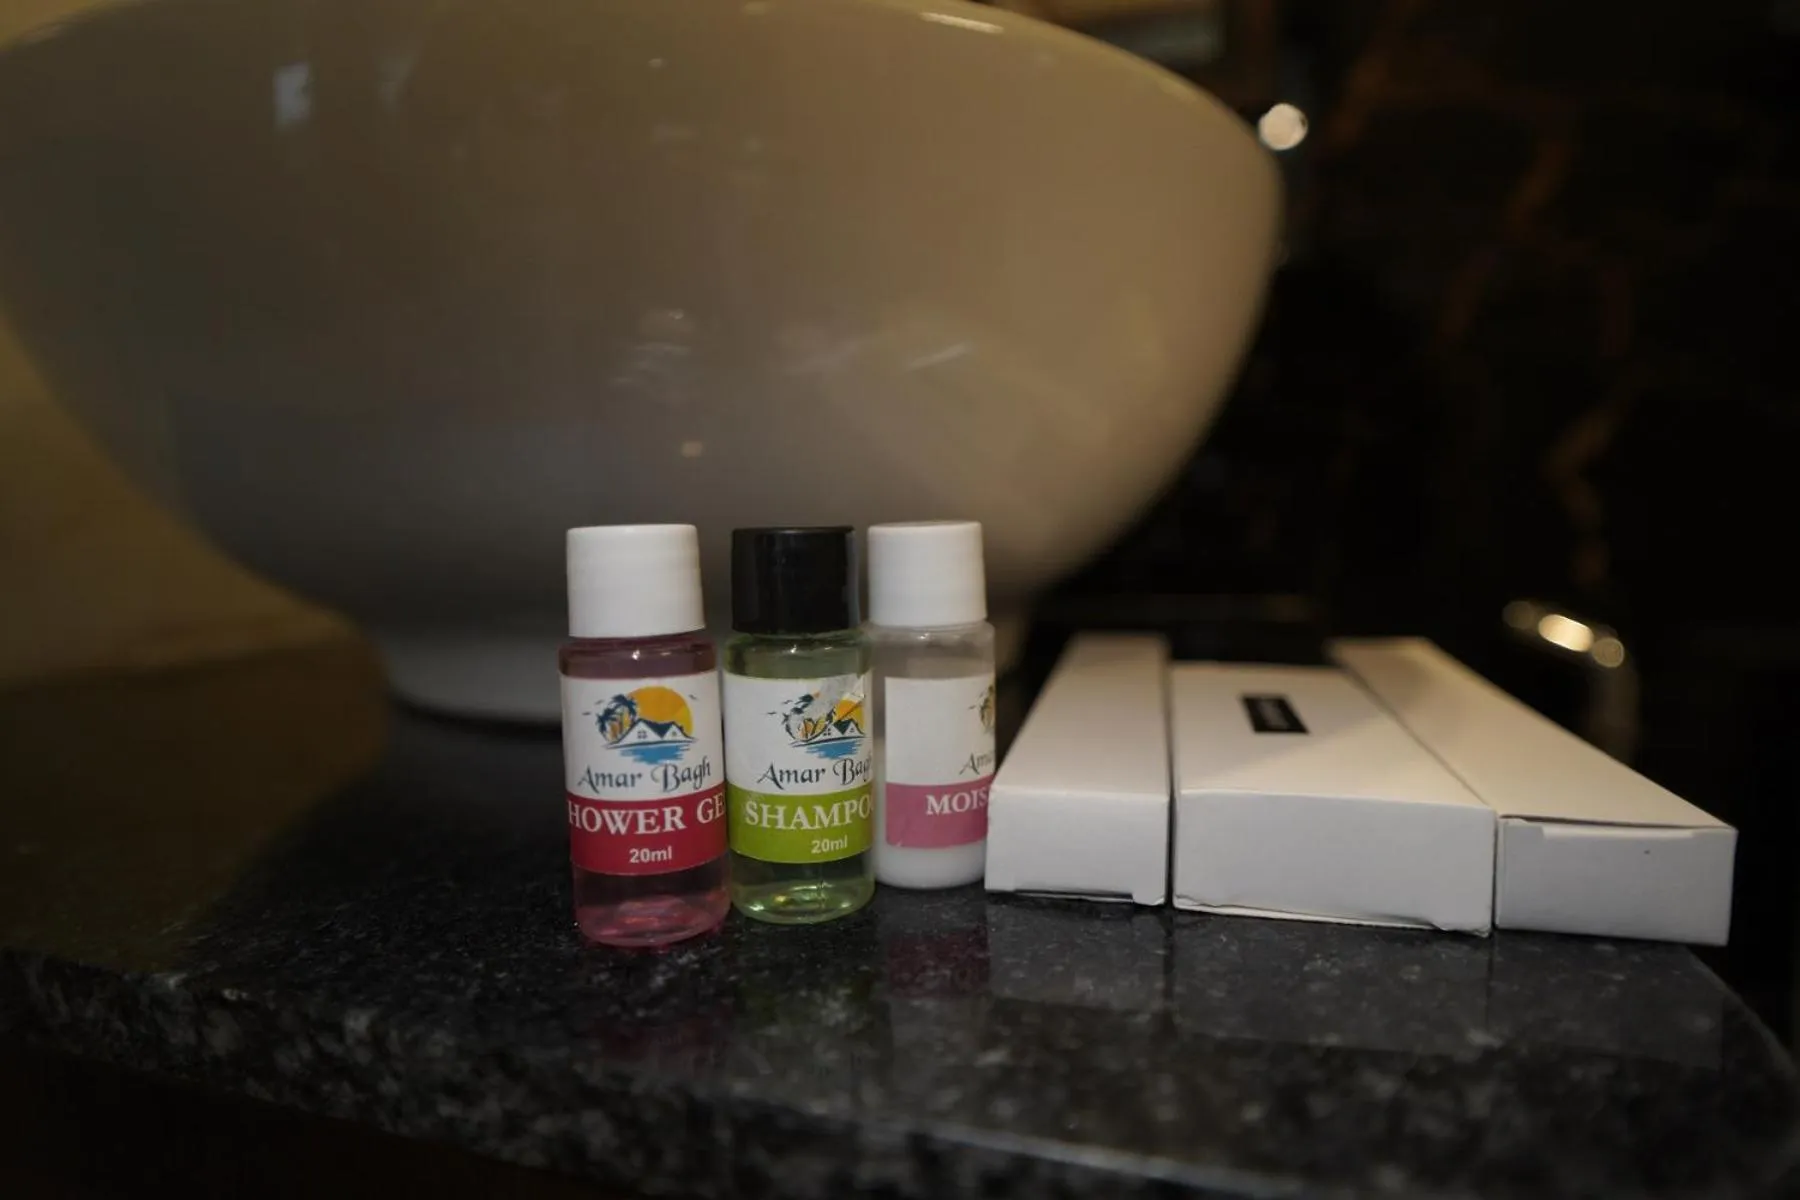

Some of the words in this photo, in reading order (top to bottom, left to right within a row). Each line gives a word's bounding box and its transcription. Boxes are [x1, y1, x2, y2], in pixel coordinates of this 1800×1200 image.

[577, 765, 643, 793] Amar
[651, 755, 711, 792] Bagh
[757, 760, 826, 790] Amar
[833, 749, 871, 785] Bag
[745, 794, 873, 830] SHAMPO
[629, 845, 673, 863] 20ml
[811, 834, 848, 854] 20ml
